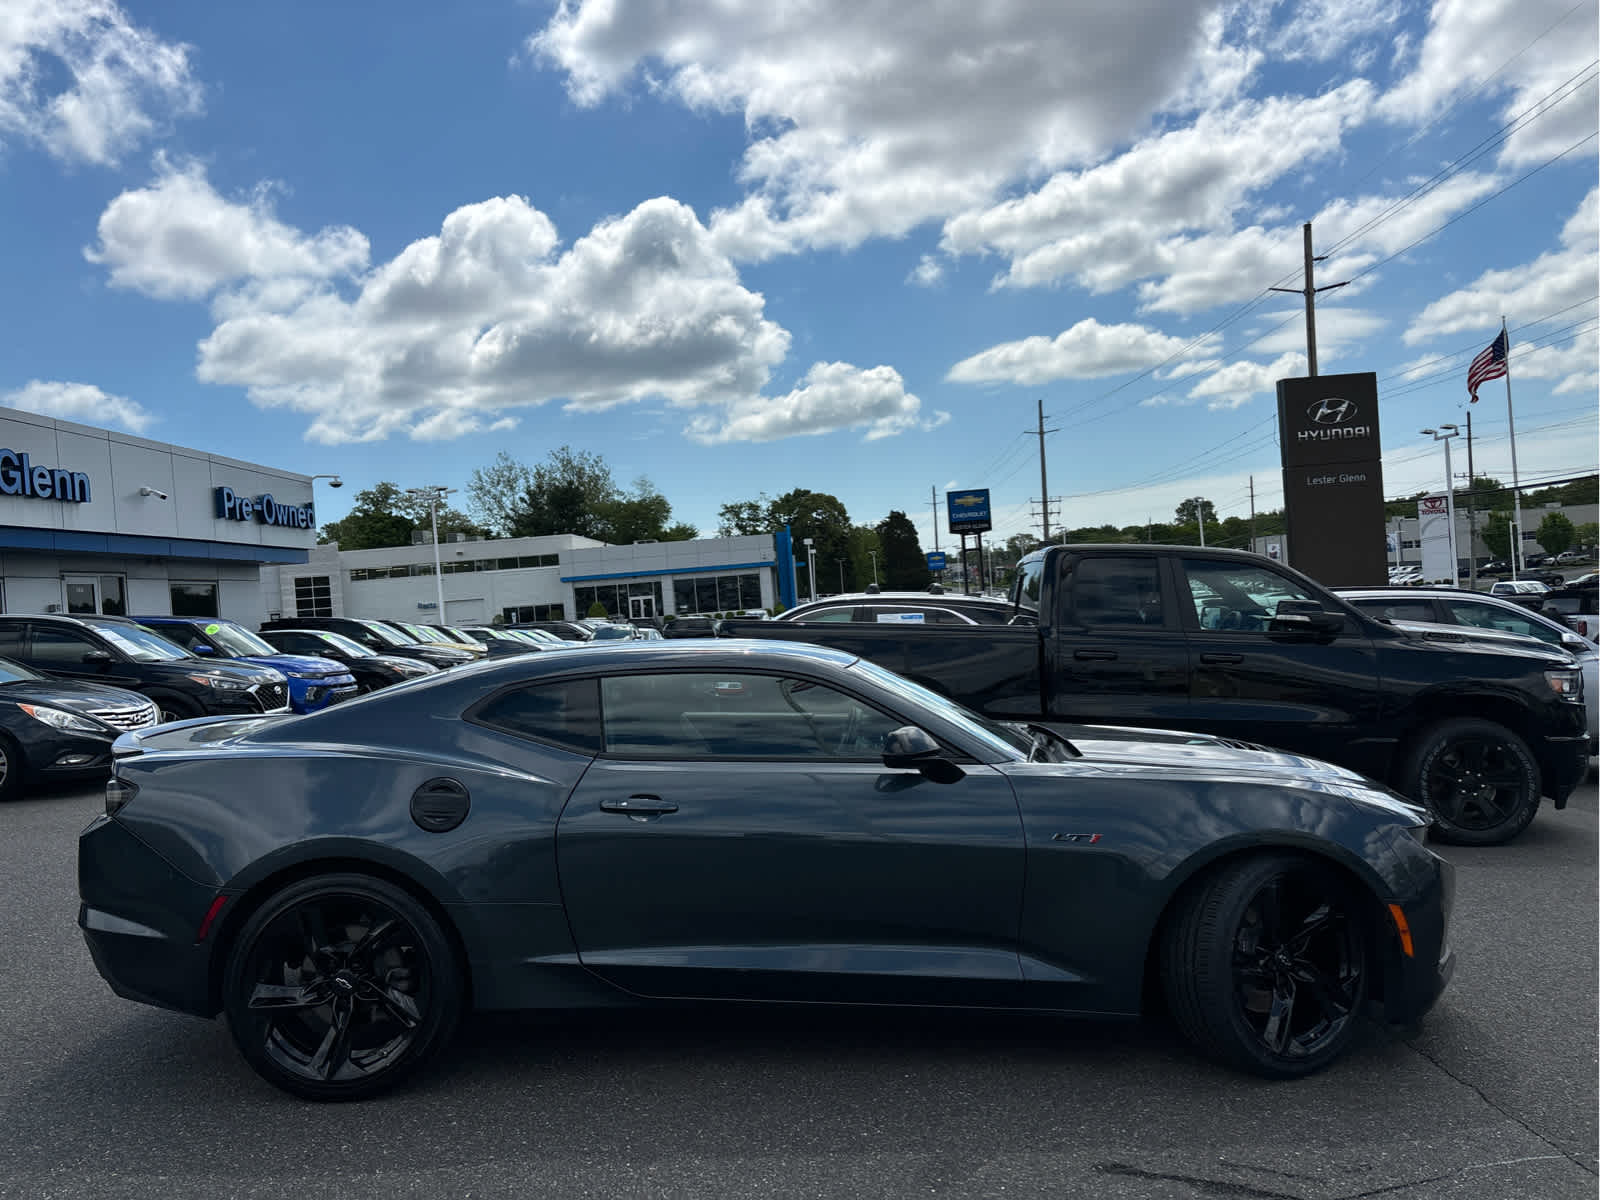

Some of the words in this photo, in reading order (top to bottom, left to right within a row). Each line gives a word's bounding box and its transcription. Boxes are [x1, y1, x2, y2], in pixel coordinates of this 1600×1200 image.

[1297, 426, 1370, 441] HYUNDAI
[0, 448, 92, 503] Glenn
[1306, 475, 1337, 486] Lester
[1339, 472, 1367, 483] Glenn
[220, 487, 316, 528] Pre-Owned
